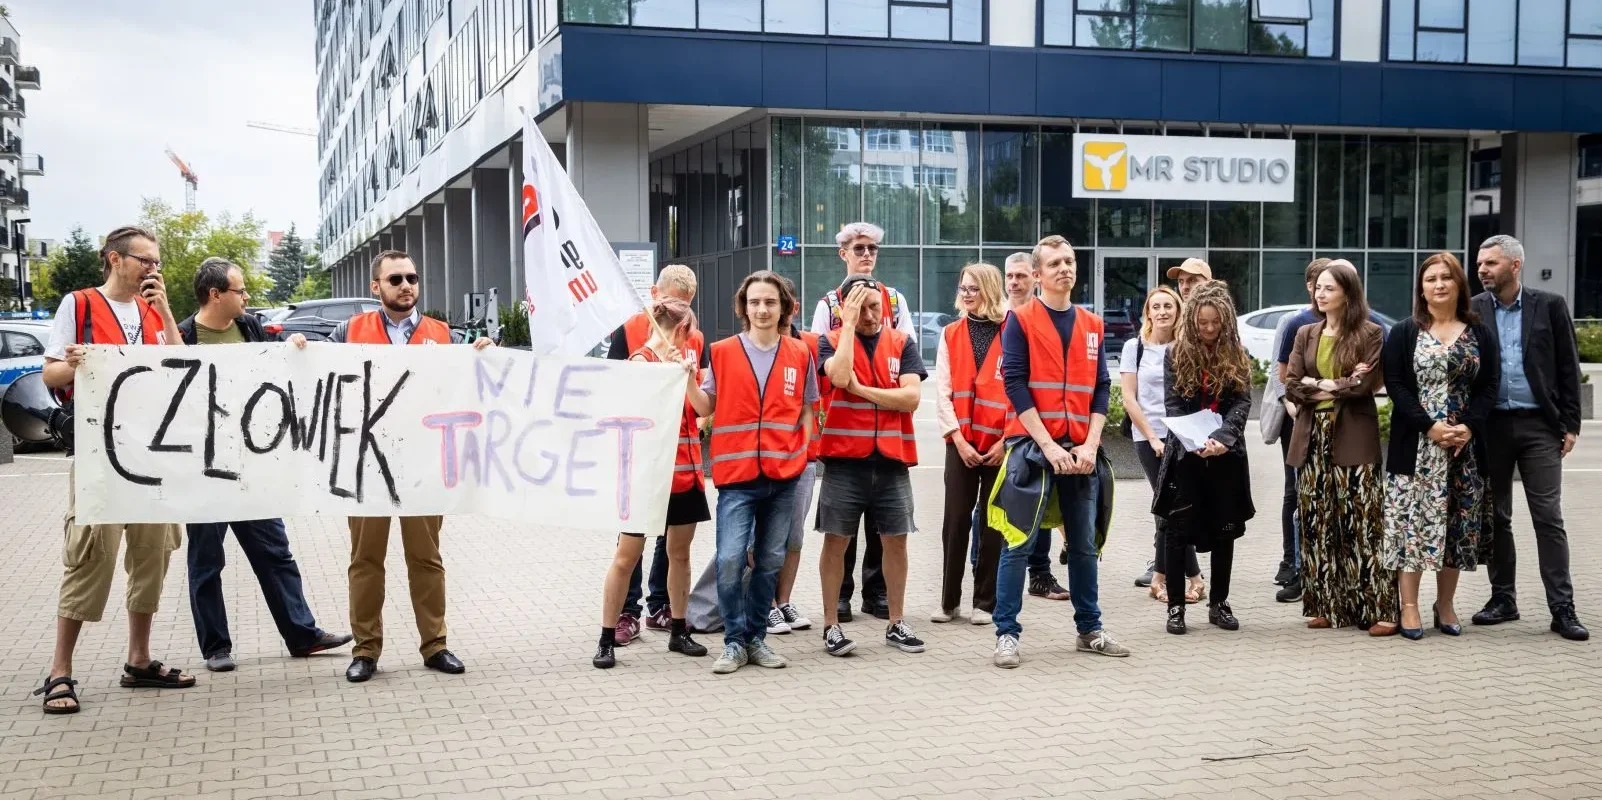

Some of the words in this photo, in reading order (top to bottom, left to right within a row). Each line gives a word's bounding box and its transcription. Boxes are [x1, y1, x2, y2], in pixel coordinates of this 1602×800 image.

[1130, 155, 1173, 181] MR
[1183, 156, 1290, 184] STUDIO
[781, 240, 793, 250] 24
[475, 357, 610, 418] NIE
[103, 358, 411, 505] CZŁOWIEK
[422, 410, 655, 520] TARGET
